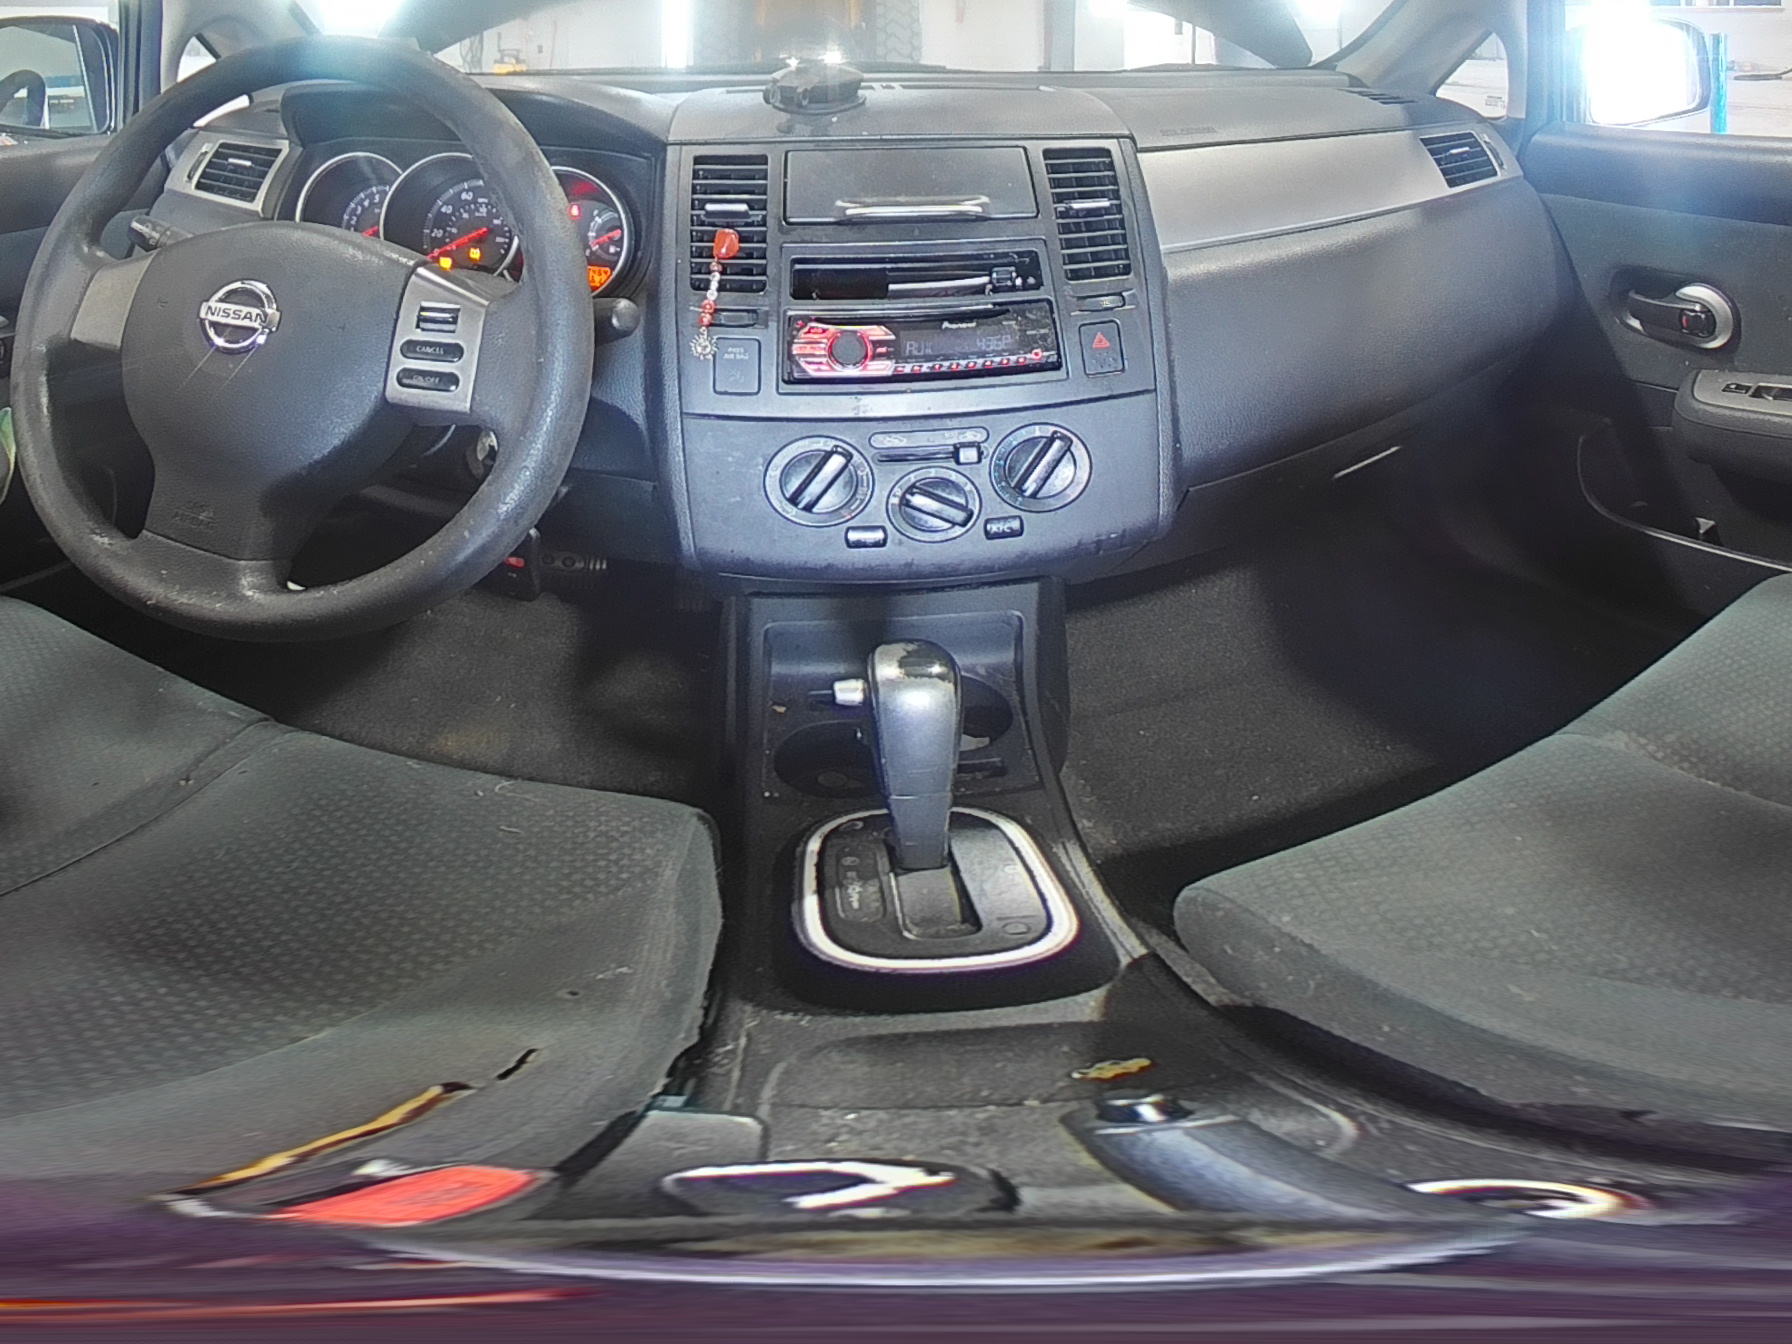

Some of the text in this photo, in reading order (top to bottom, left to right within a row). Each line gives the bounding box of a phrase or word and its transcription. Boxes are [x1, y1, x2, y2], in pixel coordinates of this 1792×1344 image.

[461, 191, 473, 201] 60
[440, 205, 453, 214] 40
[431, 228, 444, 238] 20
[205, 305, 269, 324] NISSAN
[416, 345, 445, 355] CANCEL
